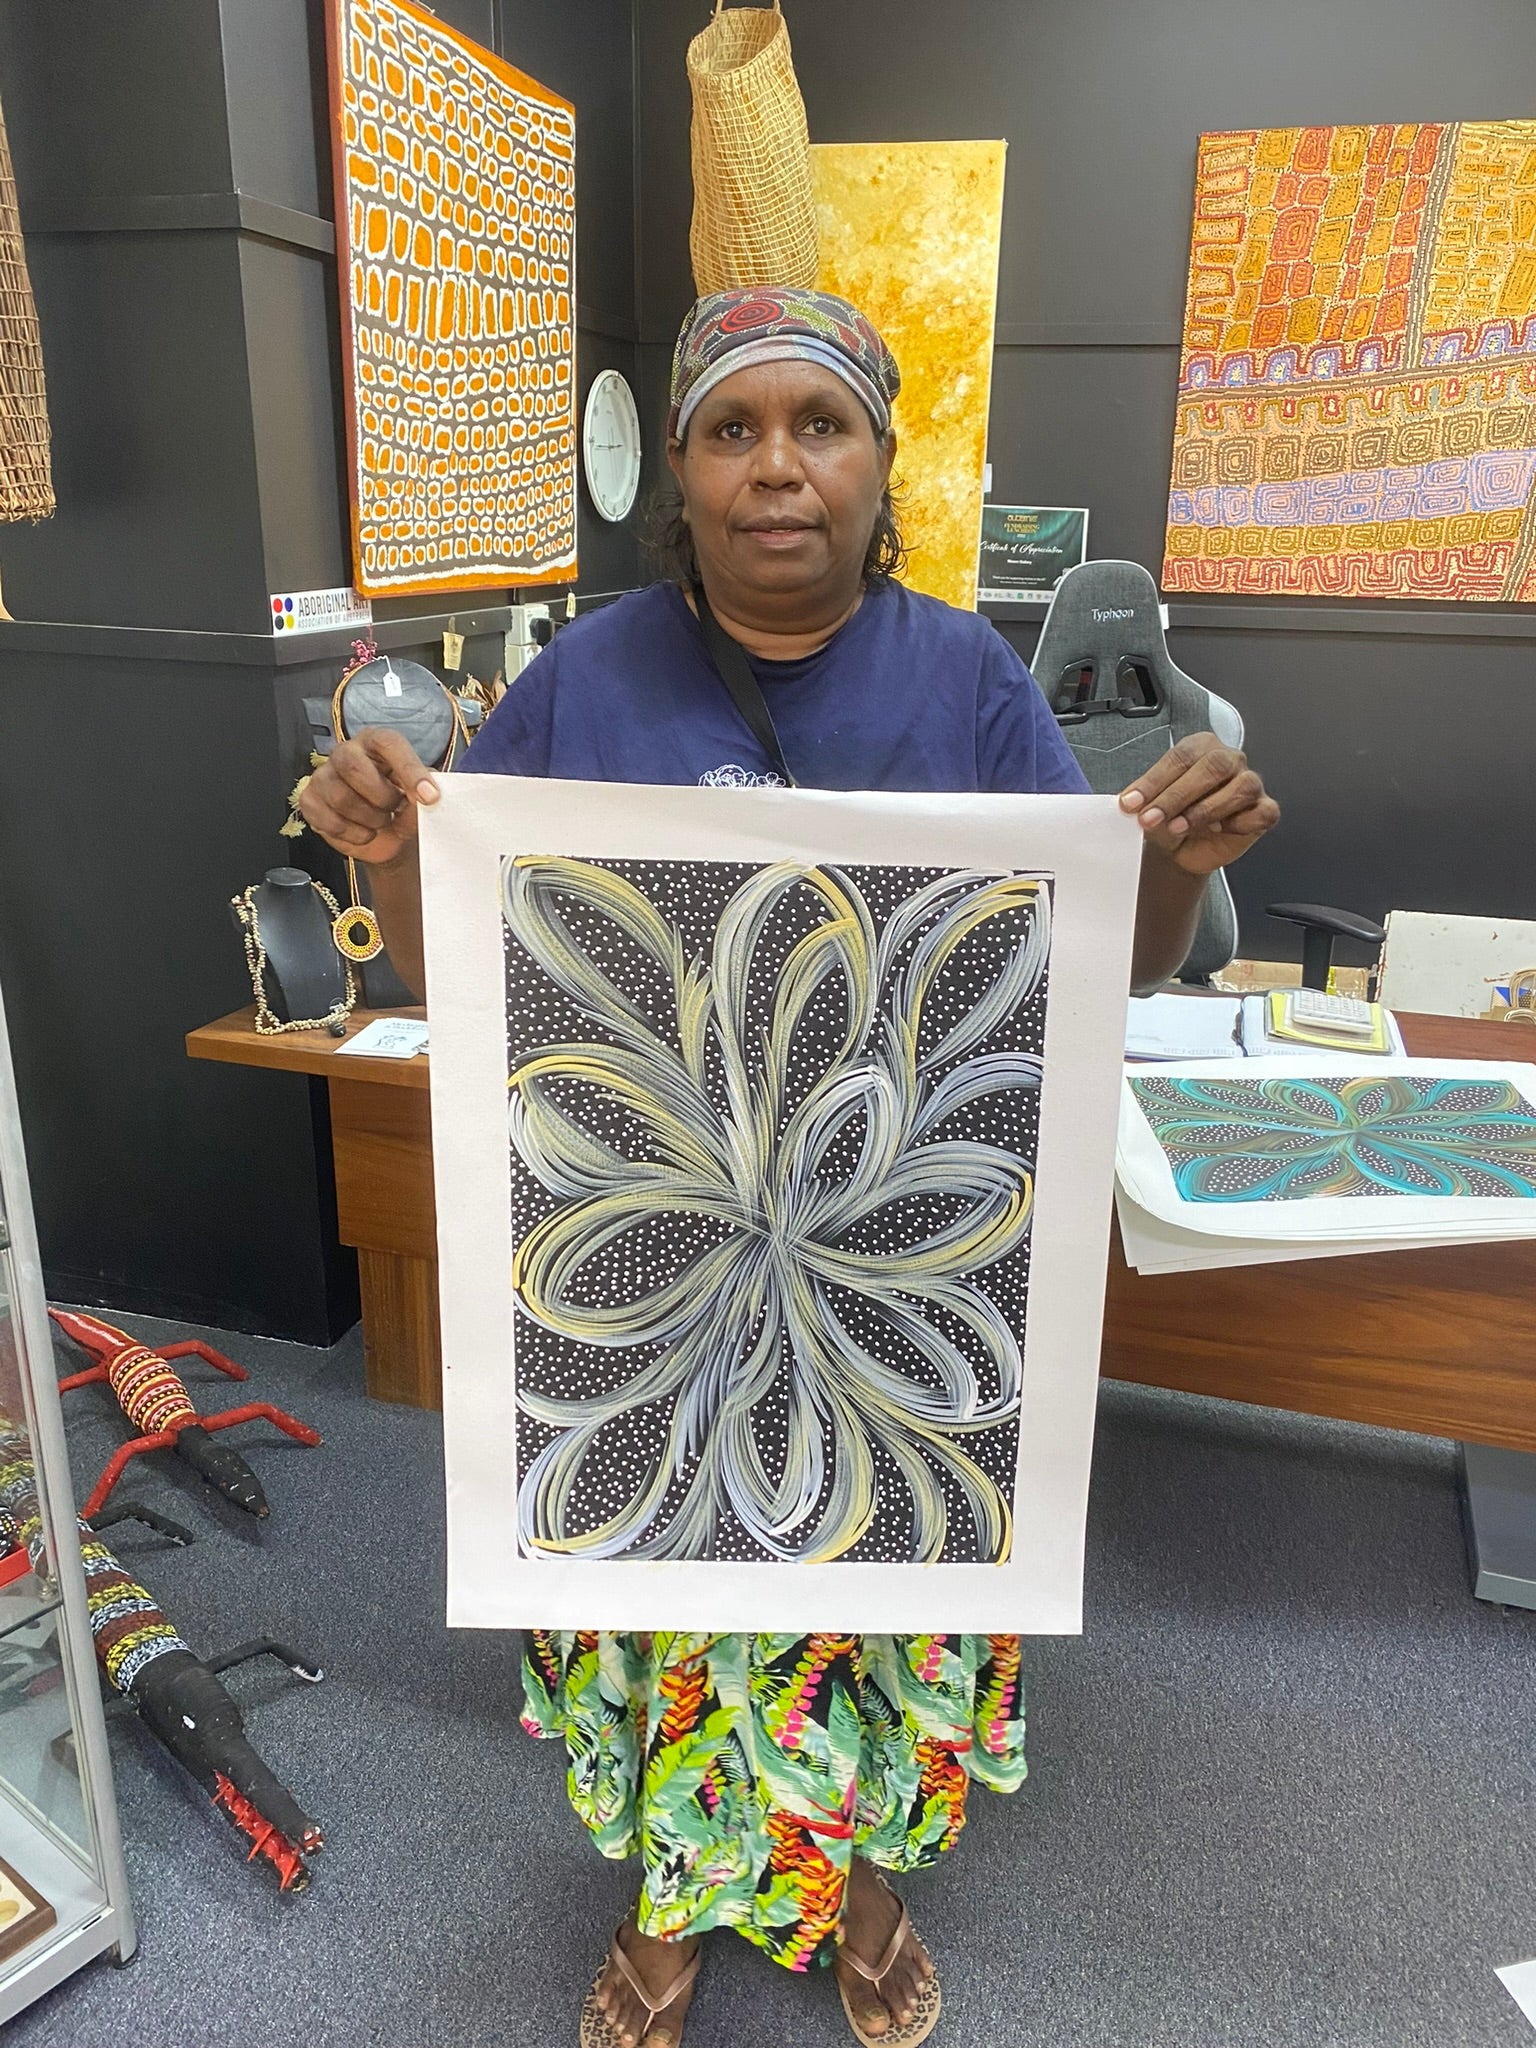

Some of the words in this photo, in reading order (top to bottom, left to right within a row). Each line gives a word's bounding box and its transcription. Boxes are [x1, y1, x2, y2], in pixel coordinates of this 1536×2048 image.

[1010, 543, 1019, 554] of
[298, 592, 351, 617] ABORIGINAL
[298, 614, 333, 629] ASSOCIATION
[1091, 607, 1134, 622] Typhoon
